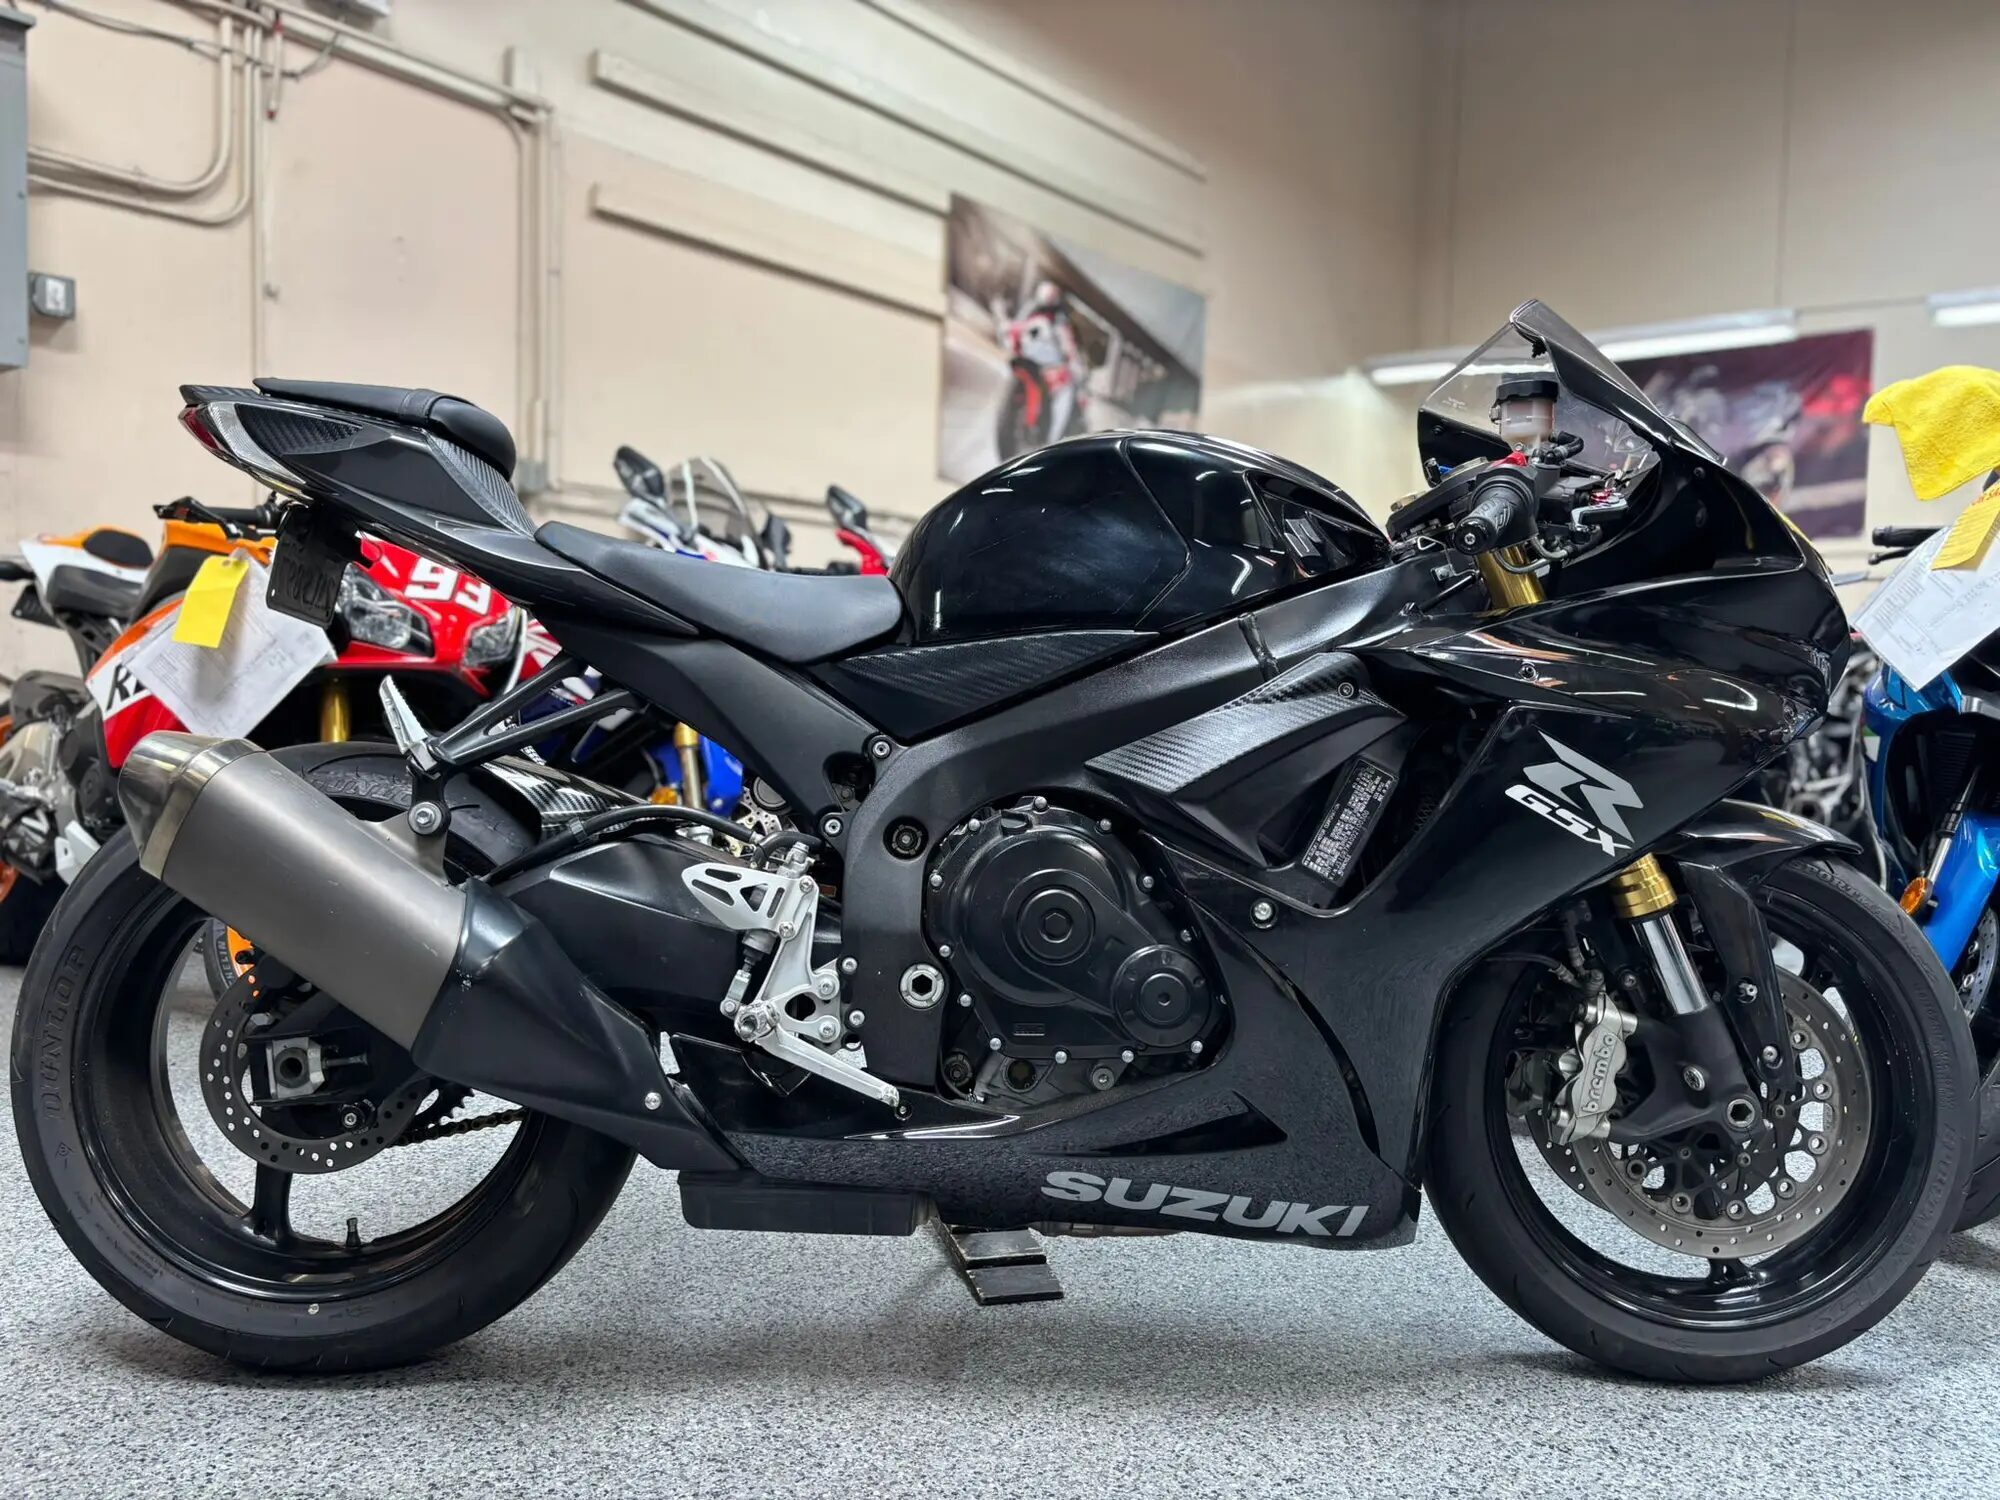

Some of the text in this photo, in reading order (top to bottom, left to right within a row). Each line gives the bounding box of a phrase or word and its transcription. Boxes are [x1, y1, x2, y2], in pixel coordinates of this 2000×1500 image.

[403, 556, 492, 616] 93
[1504, 784, 1633, 858] GSX
[40, 944, 86, 1121] DUNLOP
[1582, 1033, 1615, 1114] brembo
[1041, 1171, 1370, 1237] SUZUKI
